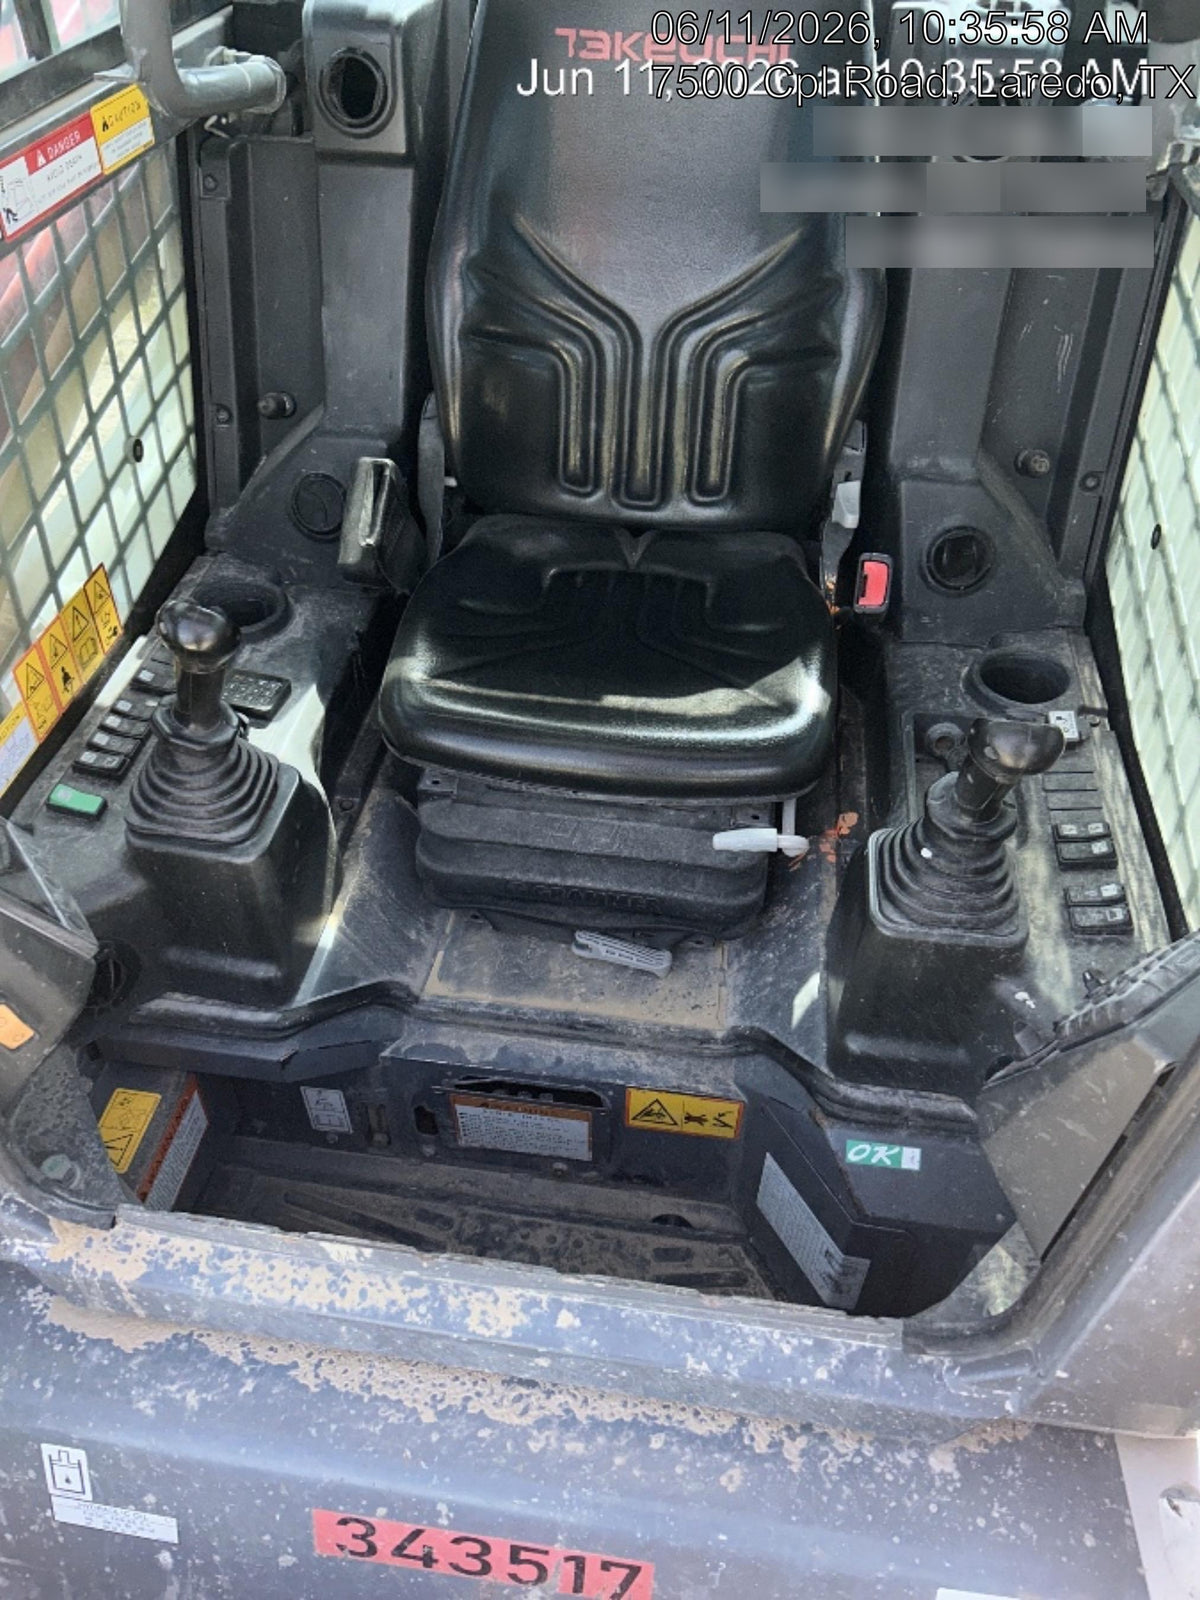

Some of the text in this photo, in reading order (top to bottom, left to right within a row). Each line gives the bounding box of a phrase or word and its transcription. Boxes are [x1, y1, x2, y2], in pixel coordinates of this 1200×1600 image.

[47, 130, 81, 160] DANGER
[847, 1144, 900, 1165] OK
[335, 1517, 642, 1600] 343517
